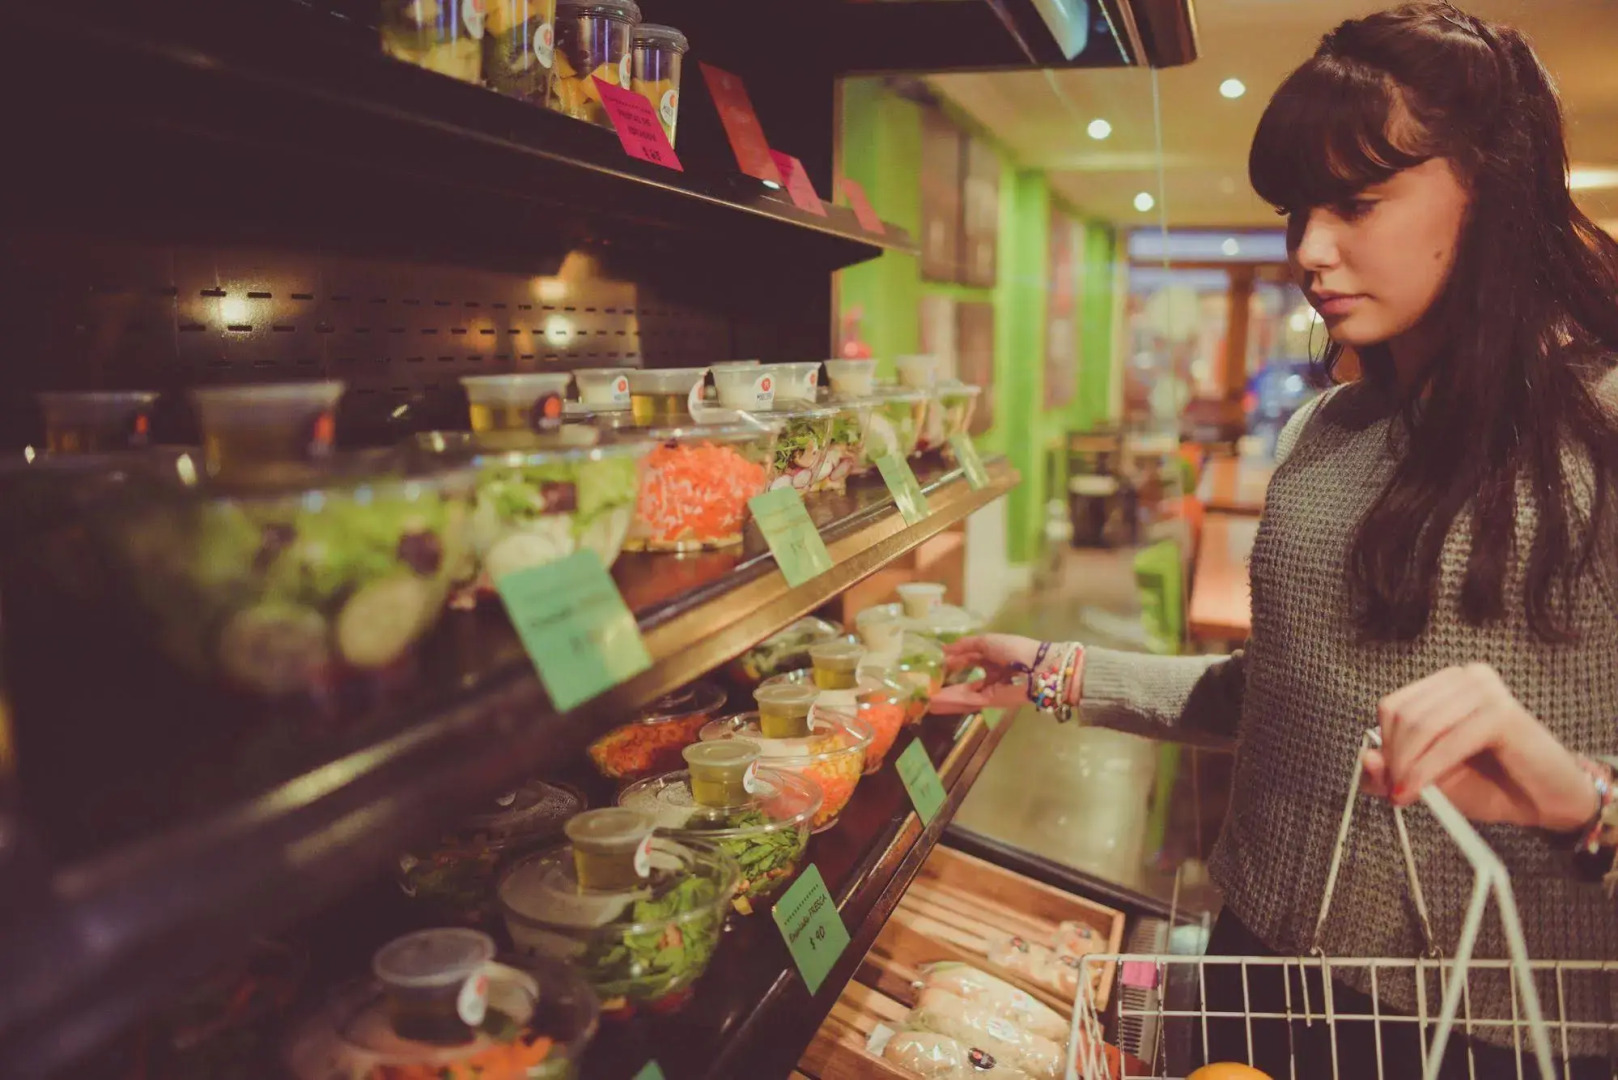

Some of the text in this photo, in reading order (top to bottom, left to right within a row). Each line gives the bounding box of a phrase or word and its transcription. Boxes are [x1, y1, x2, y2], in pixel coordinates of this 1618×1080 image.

[808, 894, 828, 918] FRESCA
[809, 925, 826, 951] $ 90
